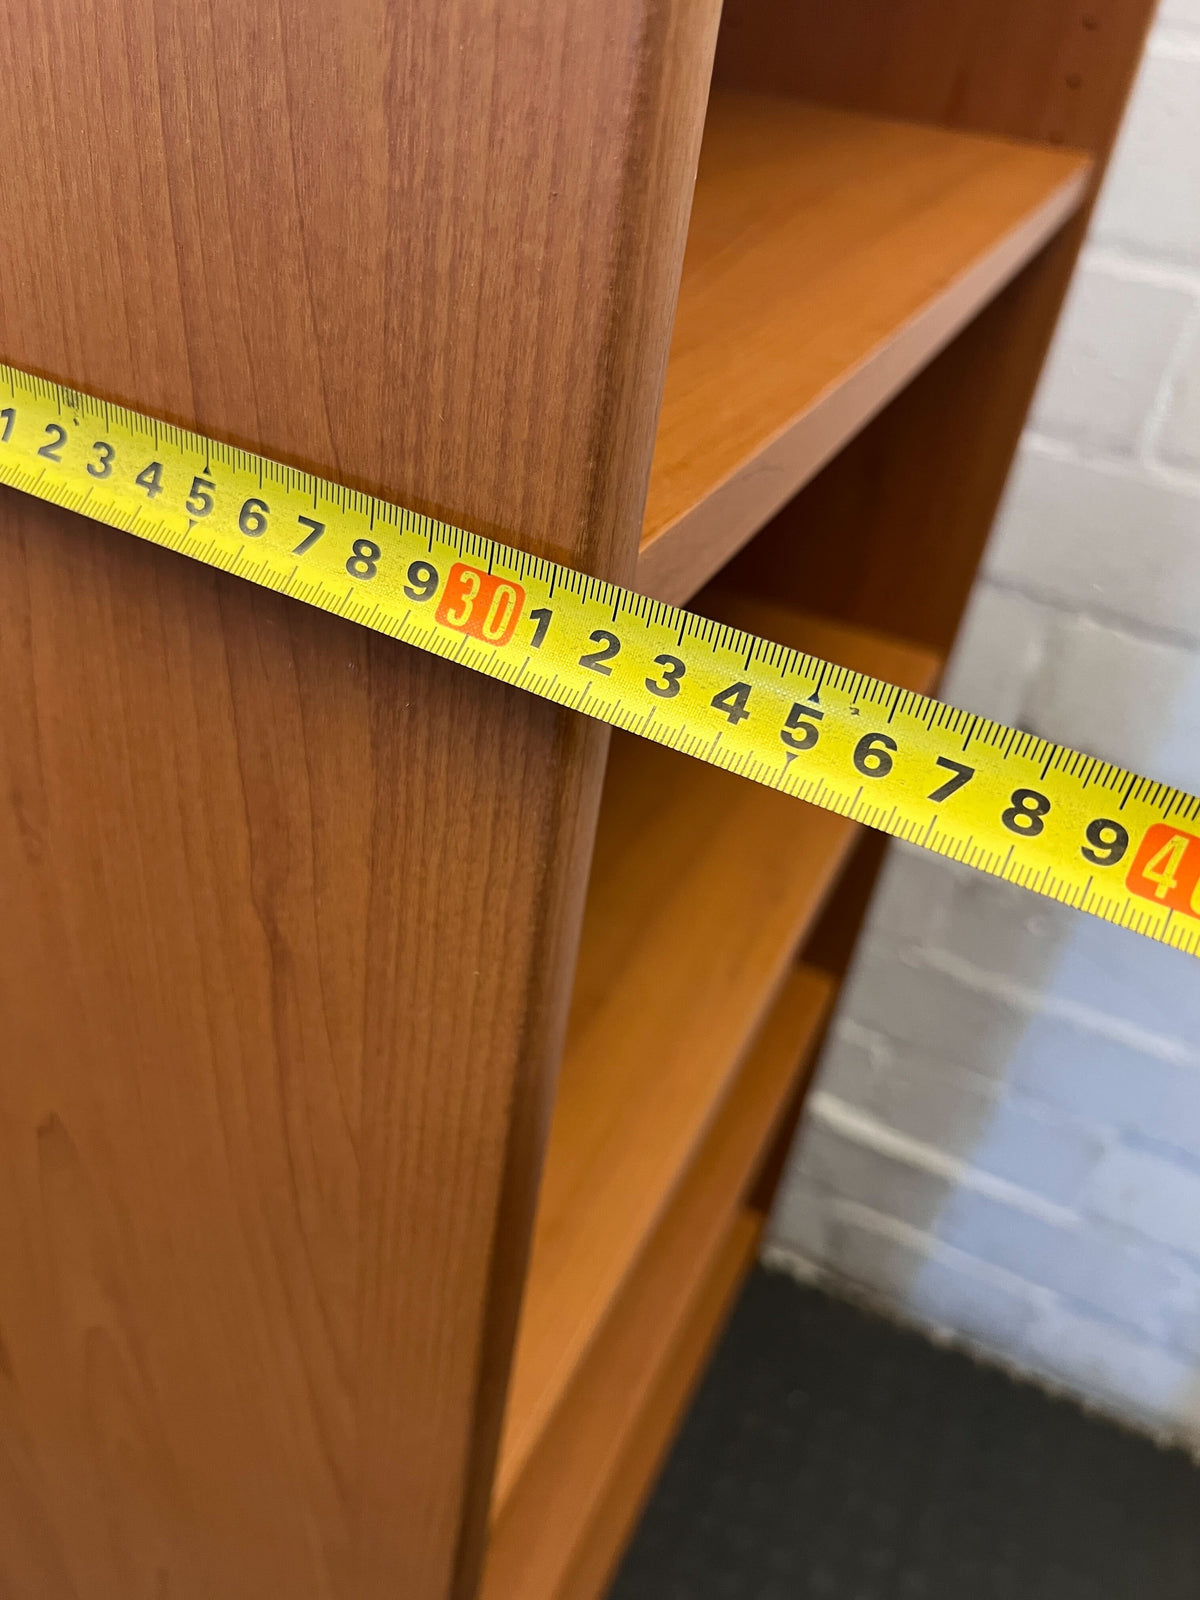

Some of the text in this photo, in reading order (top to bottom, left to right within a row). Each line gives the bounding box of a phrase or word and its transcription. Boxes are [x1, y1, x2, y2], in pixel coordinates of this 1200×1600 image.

[0, 408, 1200, 915] 1 2 3 4 5 6 7 8 9 30 1 2 3 4 5 6 7 8 9 4
